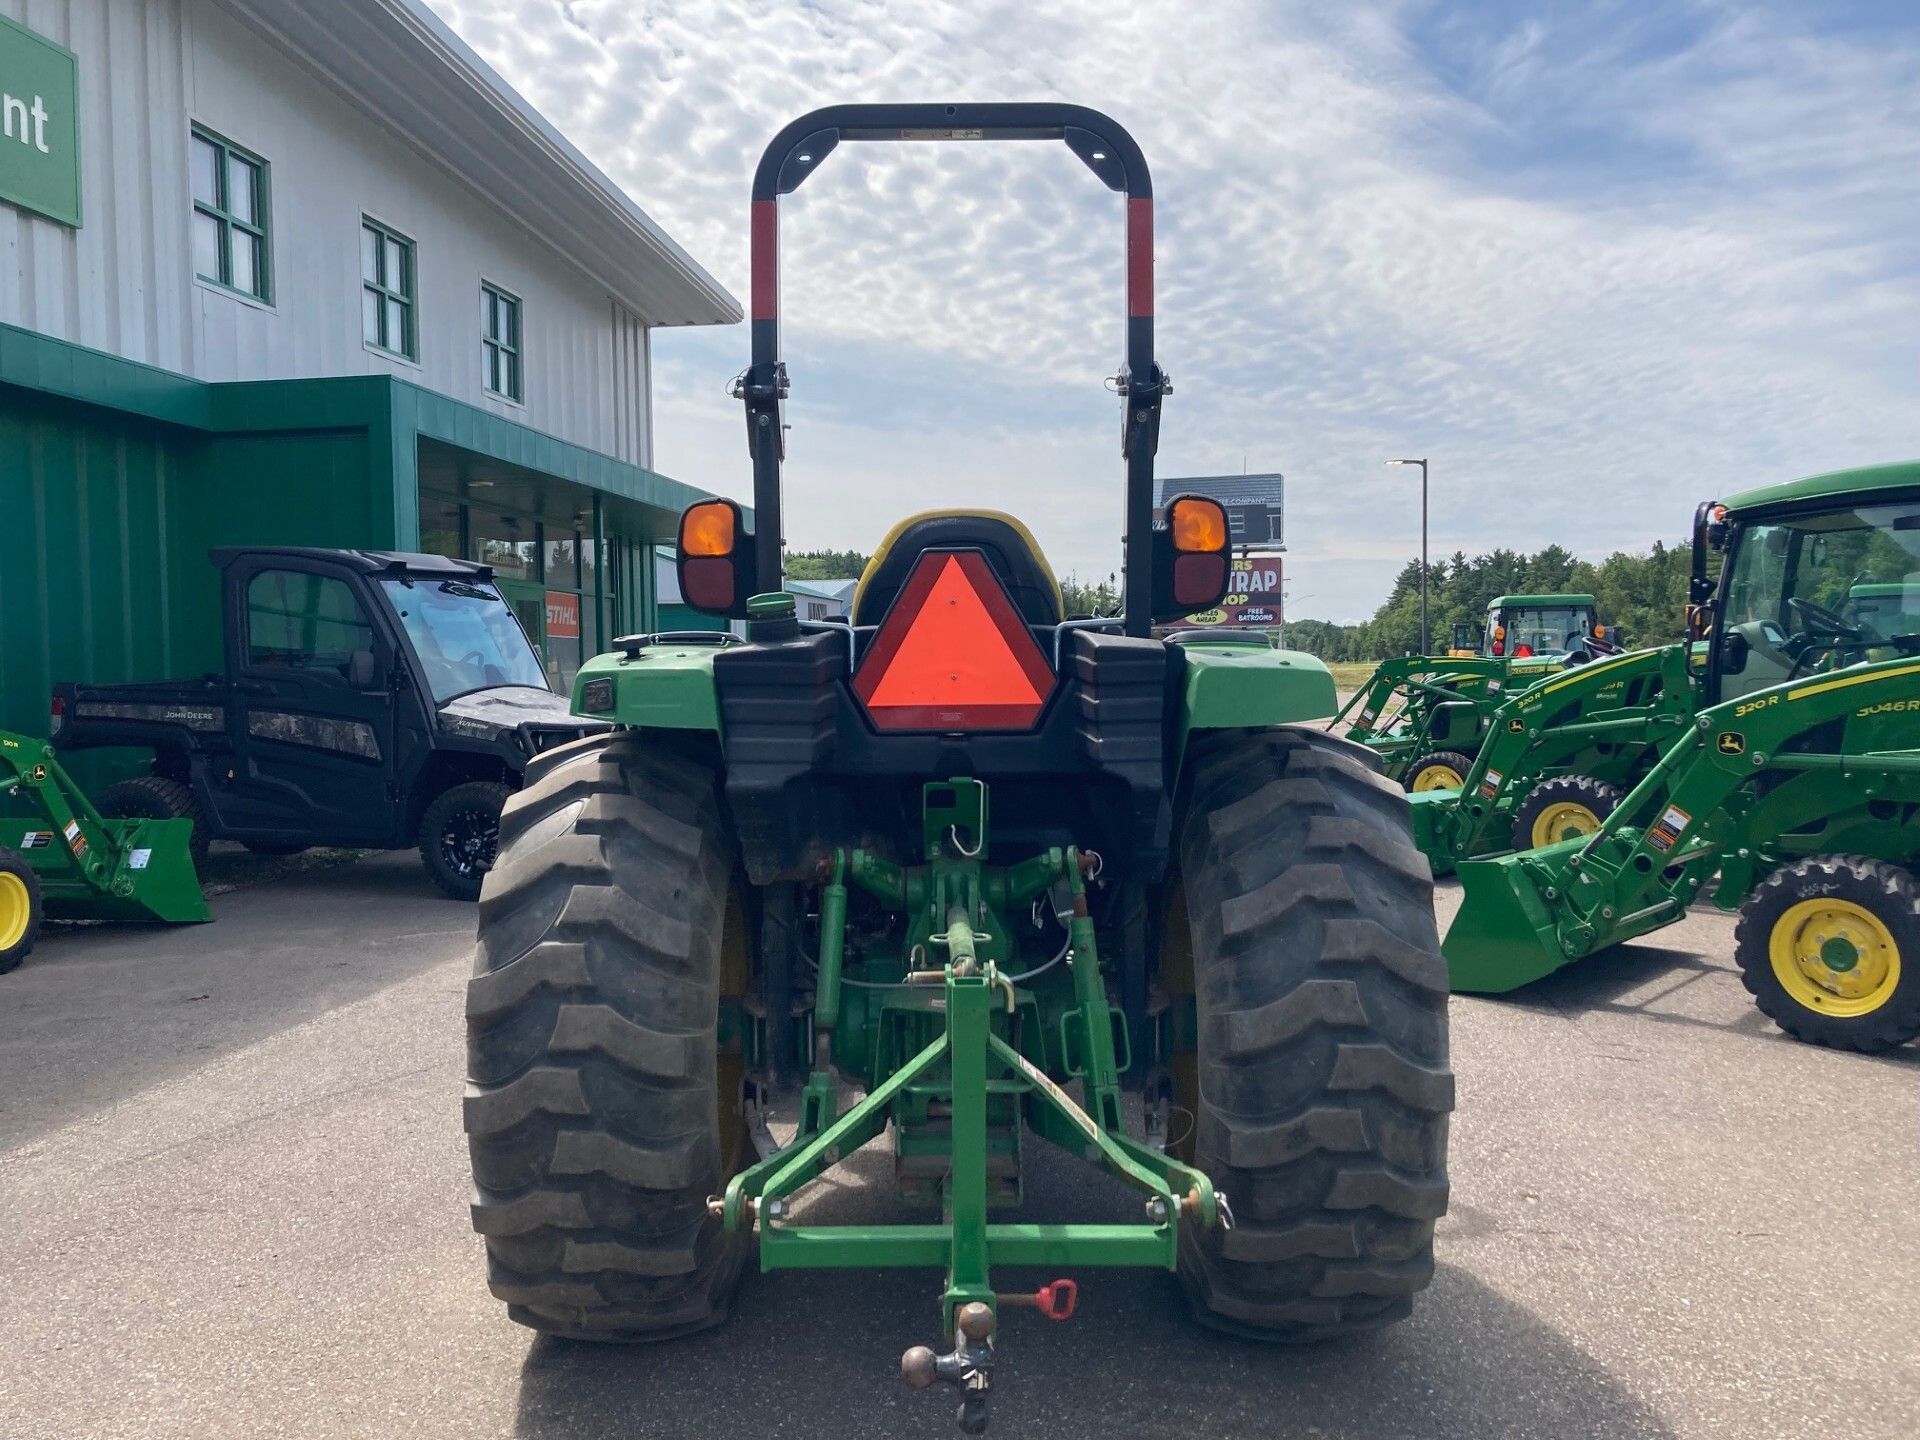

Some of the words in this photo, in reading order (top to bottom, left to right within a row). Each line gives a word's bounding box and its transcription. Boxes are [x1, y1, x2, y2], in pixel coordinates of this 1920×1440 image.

[3, 93, 49, 154] nt
[1231, 560, 1253, 571] RS
[1227, 570, 1278, 592] TRAP
[547, 605, 577, 625] STIHL
[1534, 692, 1542, 700] R
[164, 711, 187, 719] JOHN
[187, 712, 214, 720] DEERE
[1735, 699, 1766, 718] 320
[1768, 695, 1780, 707] R
[1856, 701, 1905, 718] 3046
[1907, 700, 1920, 711] R
